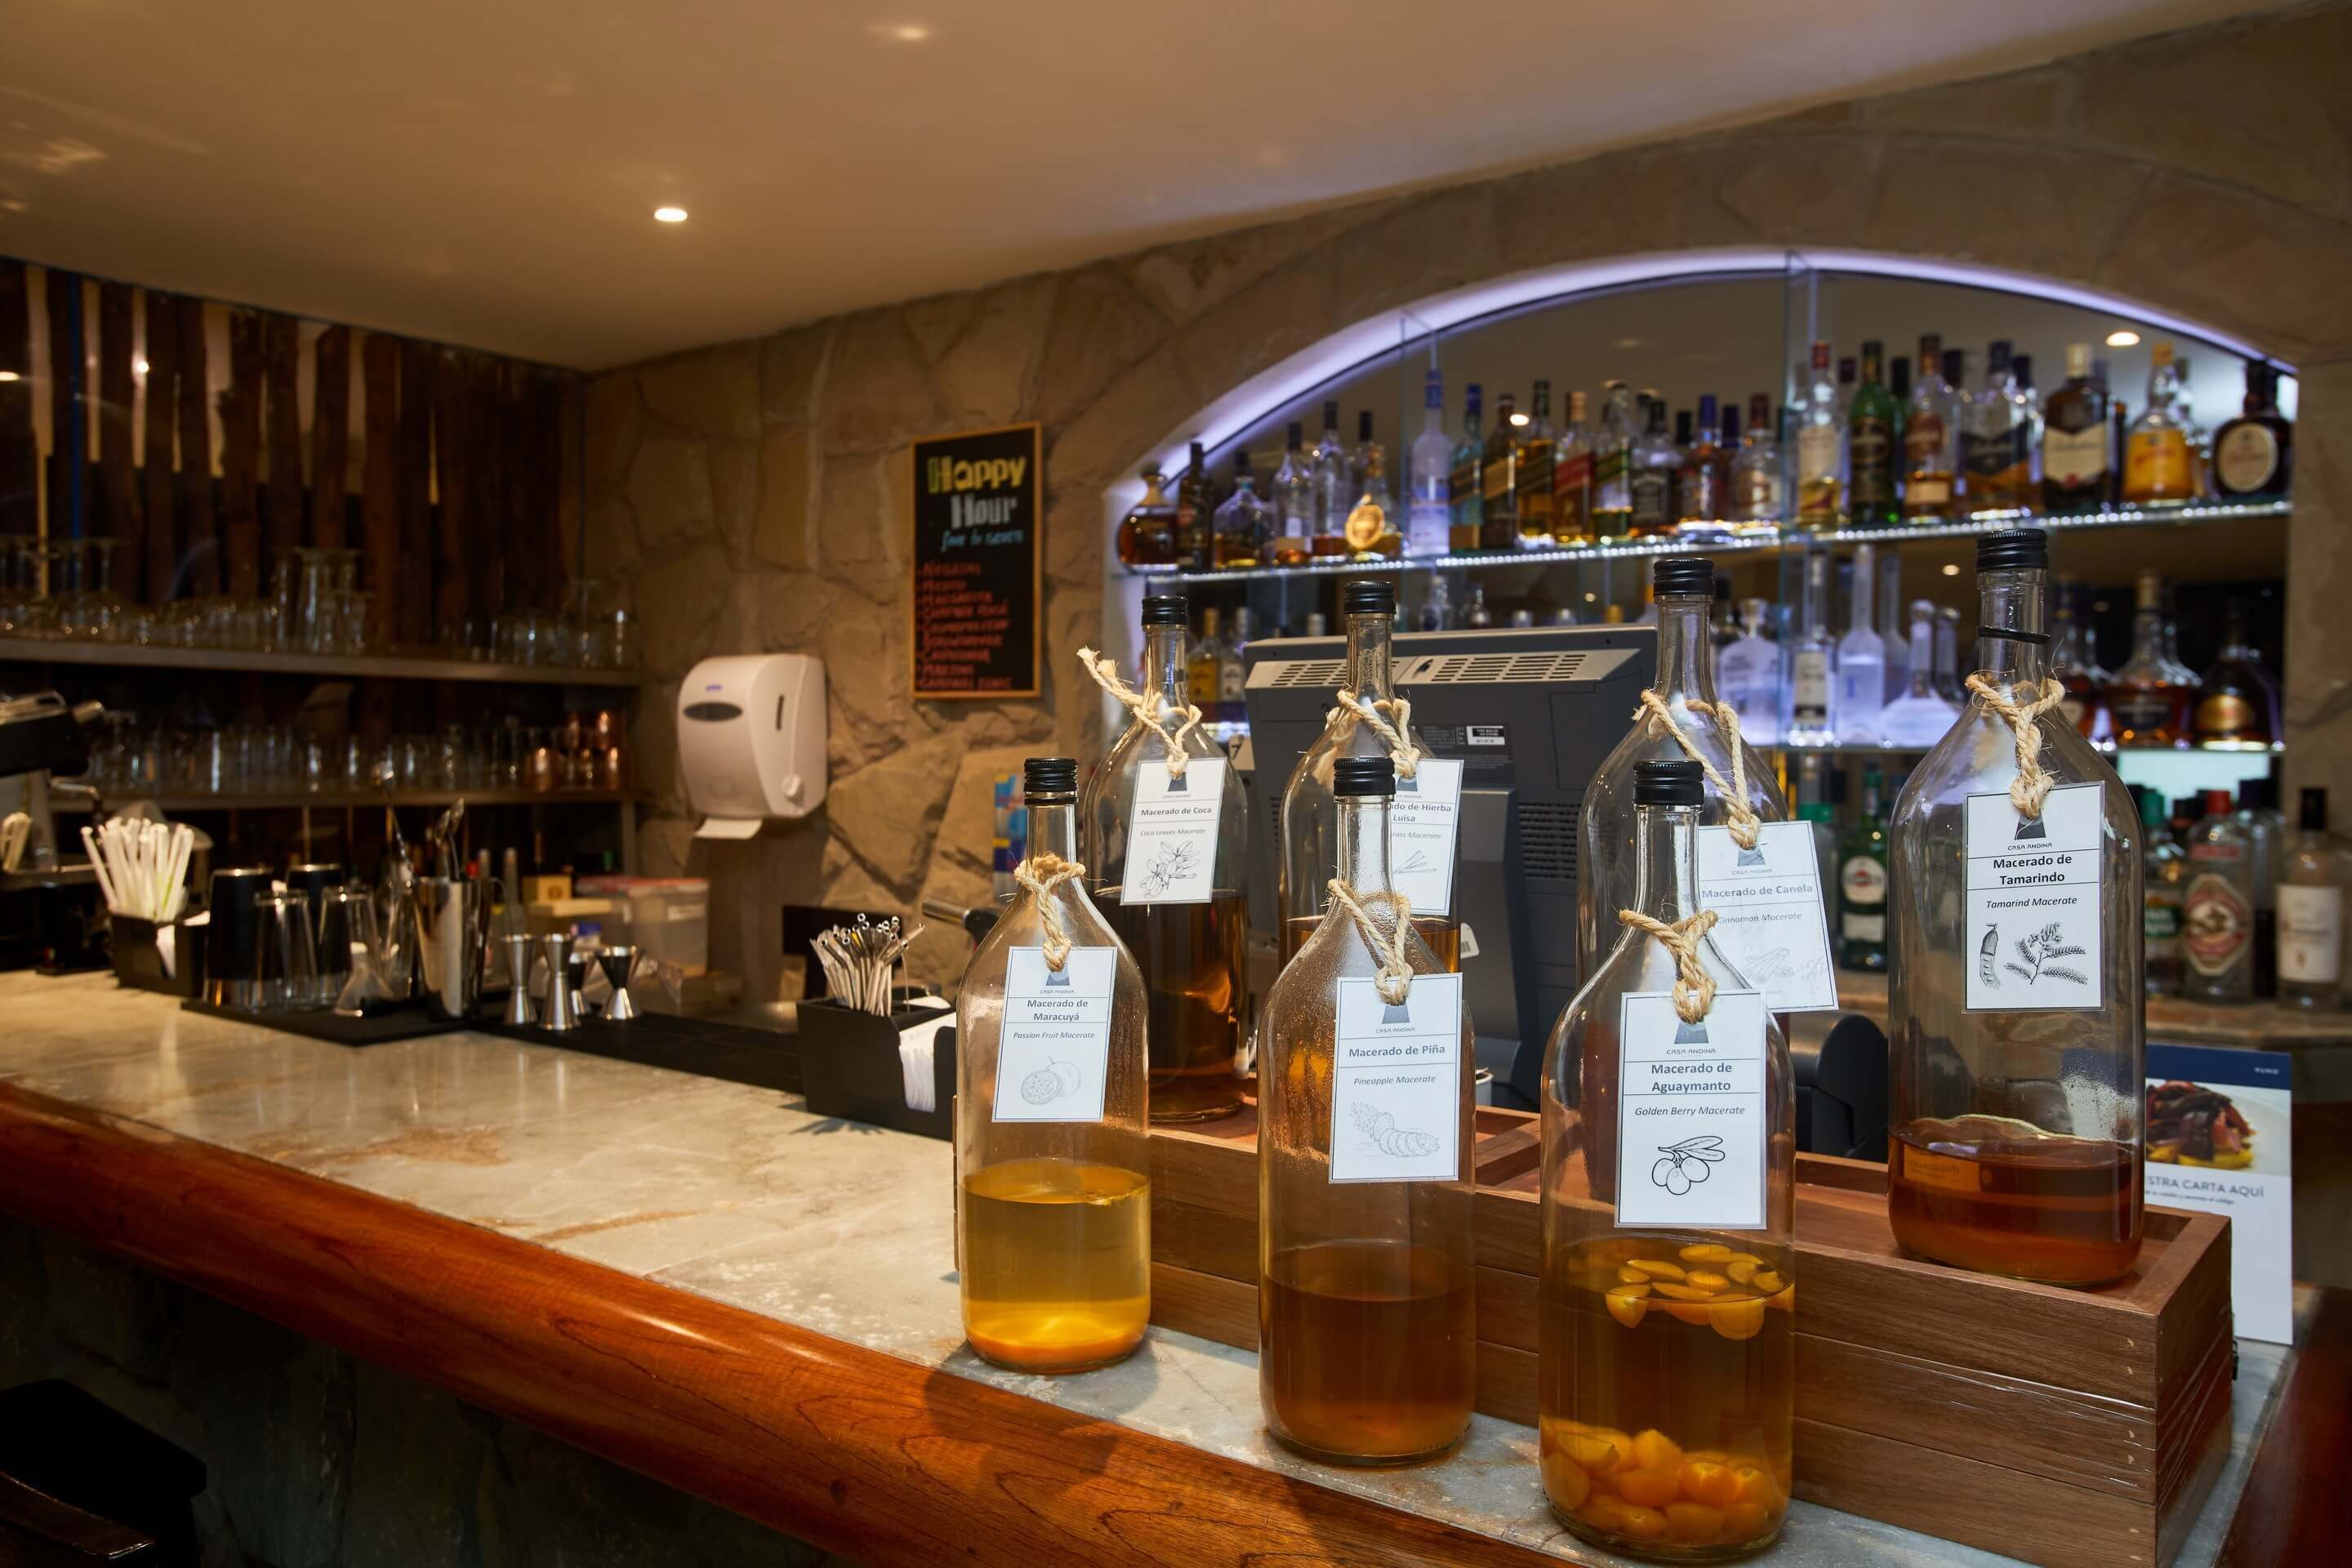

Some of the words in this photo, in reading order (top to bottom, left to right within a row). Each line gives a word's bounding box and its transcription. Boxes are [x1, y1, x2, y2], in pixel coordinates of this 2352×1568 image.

[928, 457, 1027, 493] Happy
[951, 493, 1018, 529] Hour
[1141, 808, 1179, 816] Macerado
[1422, 804, 1451, 812] Hierba
[1993, 856, 2053, 869] Macerado
[2056, 854, 2072, 865] de
[1999, 871, 2065, 885] Tamarindo
[1702, 889, 1756, 899] Macerado
[1760, 887, 1773, 895] de
[1776, 884, 1813, 895] Canela
[1986, 898, 2029, 909] Tamarind
[2032, 896, 2078, 906] Macerate
[1761, 913, 1802, 922] Macerate
[1027, 1000, 1074, 1008] Macerado
[1033, 1013, 1080, 1022] Maracuyá
[1349, 1048, 1402, 1058] Macerado
[1402, 1046, 1419, 1055] de
[1422, 1045, 1446, 1054] Piña
[1651, 1063, 1713, 1075] Macerado
[1717, 1062, 1732, 1073] de
[1353, 1076, 1394, 1086] Pineapple
[1396, 1076, 1437, 1084] Macerate
[1651, 1081, 1731, 1094] Aguaymanto
[1635, 1107, 1668, 1116] Golden
[1671, 1107, 1696, 1116] Berry
[1699, 1106, 1745, 1116] Macerate
[2147, 1176, 2179, 1189] STRA
[2183, 1178, 2226, 1194] CARTA
